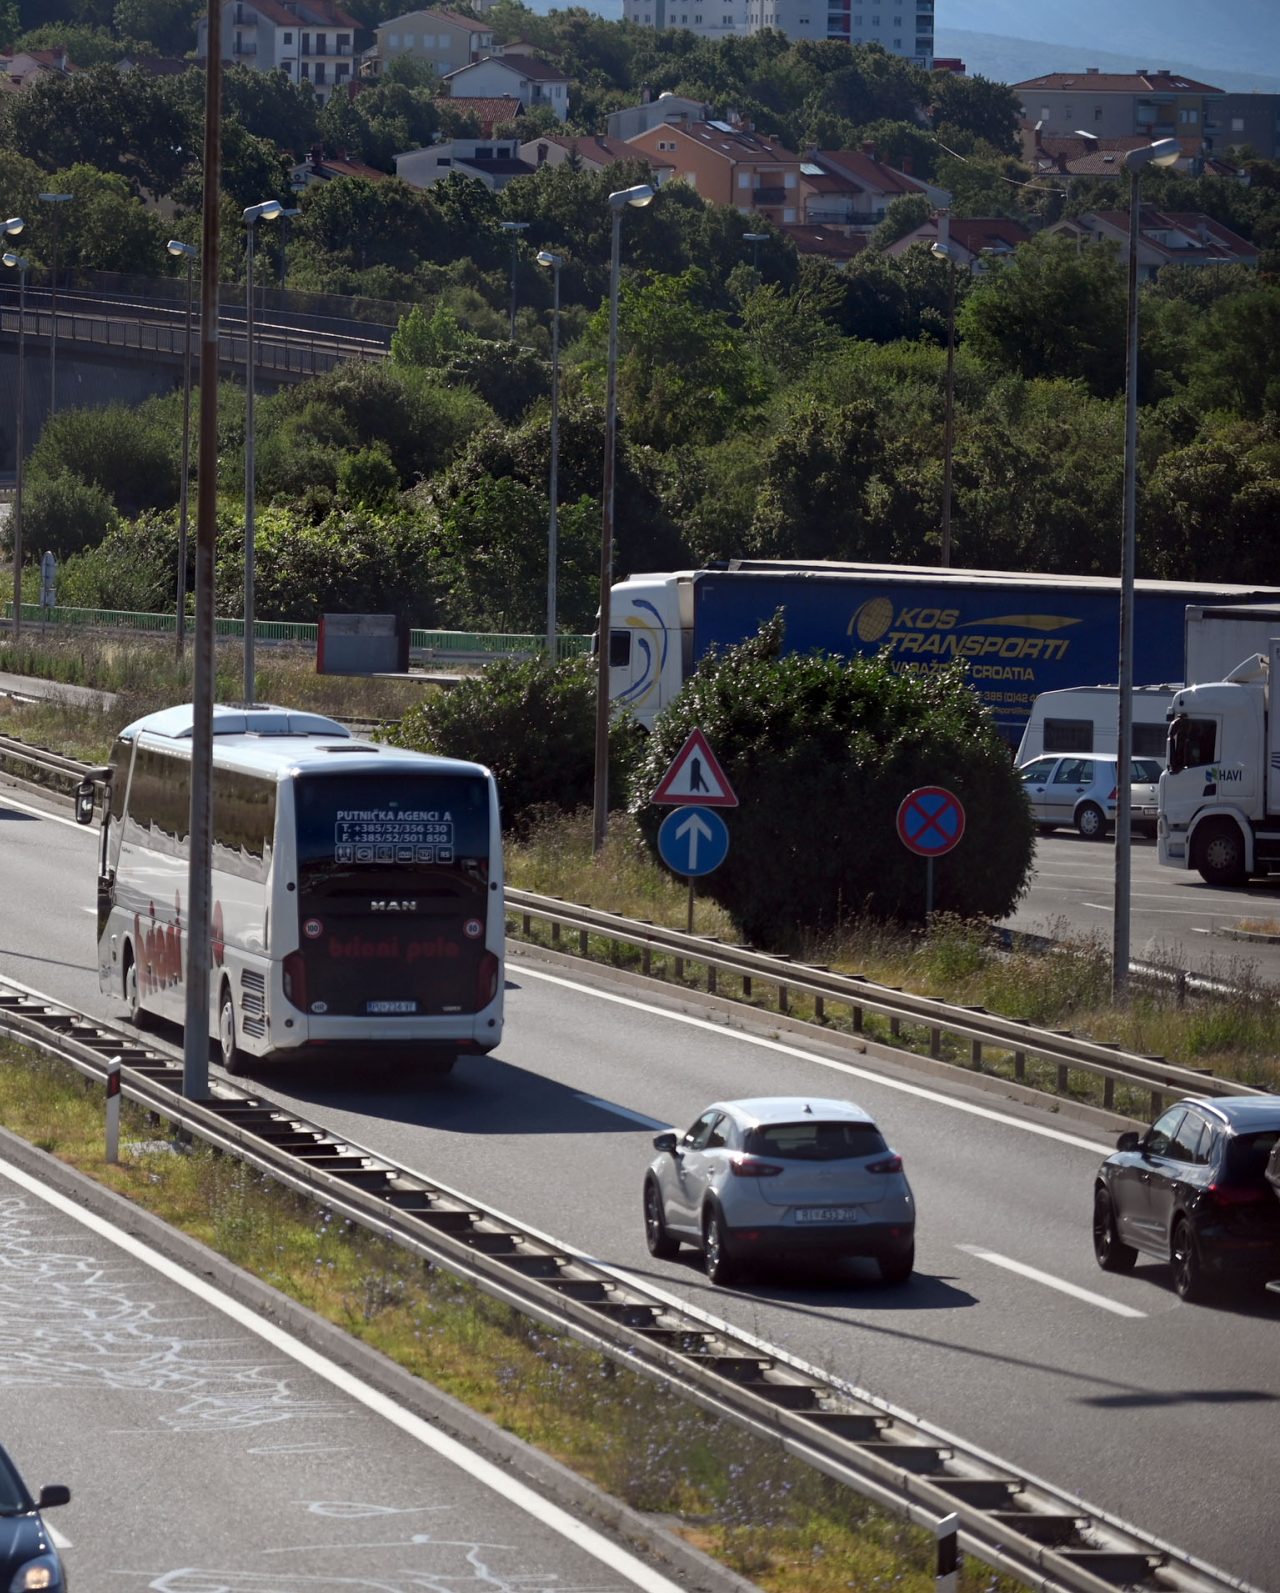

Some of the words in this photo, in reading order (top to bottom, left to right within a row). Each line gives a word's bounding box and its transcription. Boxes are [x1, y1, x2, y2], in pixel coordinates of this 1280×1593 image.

[895, 607, 960, 629] KOS
[887, 631, 1070, 660] TRANSPORTI
[973, 664, 1035, 681] CROATIA
[1219, 769, 1242, 781] HAVI
[342, 824, 352, 833] T.
[426, 824, 448, 833] 530
[342, 834, 352, 842] F.
[371, 901, 417, 911] MAN
[307, 924, 319, 932] 100
